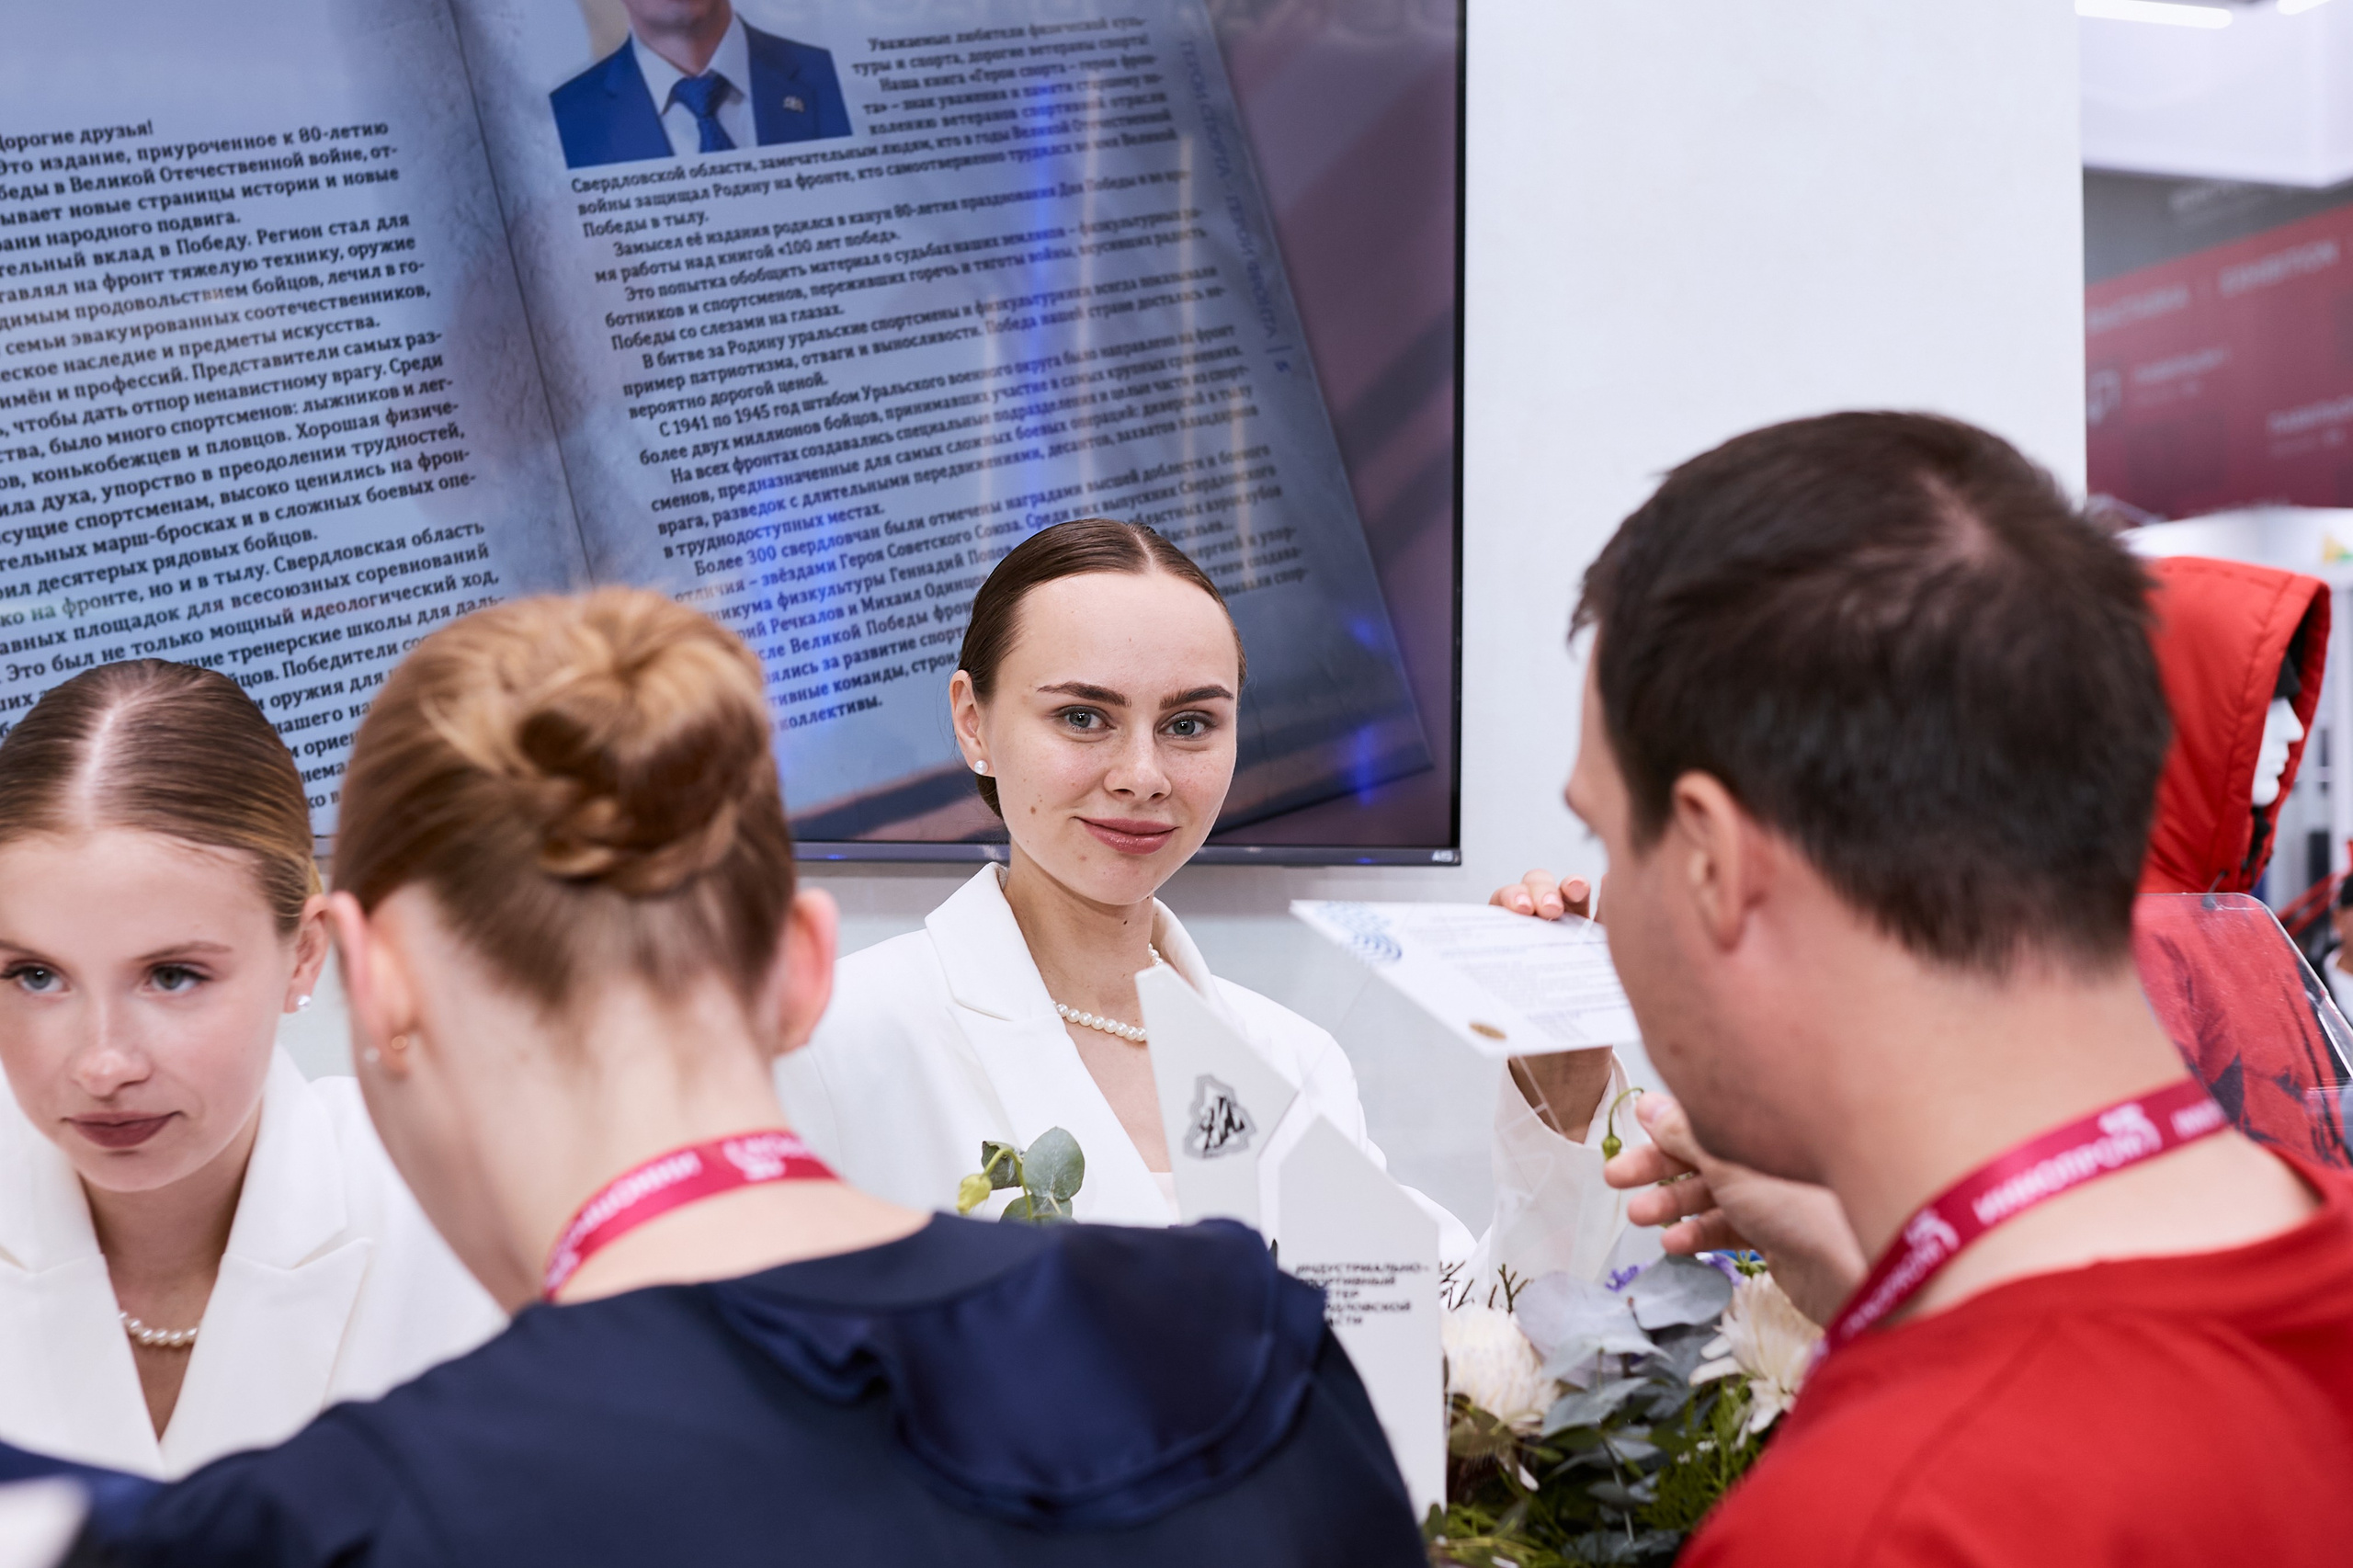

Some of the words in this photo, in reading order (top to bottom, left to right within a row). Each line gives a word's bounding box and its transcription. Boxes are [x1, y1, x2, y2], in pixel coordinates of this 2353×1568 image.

[40, 151, 131, 171] издание,
[137, 134, 277, 164] приуроченное
[298, 122, 389, 143] 80-летию
[80, 119, 153, 145] друзья!
[69, 168, 156, 193] Великой
[159, 152, 304, 183] Отечественной
[308, 147, 368, 166] войне,
[69, 199, 131, 219] новые
[137, 187, 235, 212] страницы
[241, 177, 320, 199] истории
[343, 168, 399, 186] новые
[571, 165, 687, 194] Свердловской
[688, 161, 758, 178] области,
[577, 198, 631, 216] войны
[634, 187, 710, 209] защищал
[711, 180, 770, 199] Родину
[795, 171, 856, 191] фронте,
[46, 222, 153, 248] народного
[156, 211, 241, 233] подвига.
[93, 246, 155, 266] вклад
[176, 234, 252, 256] Победу.
[256, 225, 324, 245] Регион
[328, 219, 370, 236] стал
[583, 219, 648, 238] Победы
[664, 210, 709, 227] тылу.
[613, 237, 684, 257] Замысел
[706, 225, 770, 244] издания
[772, 216, 835, 239] родился
[102, 269, 165, 293] фронт
[168, 258, 258, 280] тяжелую
[261, 247, 344, 268] технику,
[347, 237, 415, 260] оружие
[620, 260, 682, 284] работы
[717, 244, 775, 266] книгой
[778, 238, 813, 256] «100
[844, 230, 901, 247] побед».
[657, 277, 728, 297] попытка
[729, 265, 807, 286] обобщить
[809, 254, 881, 274] материал
[5, 335, 67, 356] семьи
[71, 312, 241, 346] эвакуированных
[244, 285, 431, 321] соотечественников,
[74, 284, 248, 322] продовольствием
[252, 275, 324, 294] бойцов,
[327, 266, 381, 285] лечил
[605, 306, 685, 328] ботников
[702, 288, 808, 313] спортсменов,
[63, 348, 156, 373] наследие
[178, 330, 278, 359] предметы
[281, 316, 381, 341] искусства.
[611, 330, 676, 350] Победы
[699, 316, 766, 336] слезами
[790, 304, 845, 323] глазах.
[656, 348, 705, 367] битве
[727, 335, 785, 356] Родину
[788, 323, 869, 349] уральские
[74, 366, 188, 401] профессий.
[191, 346, 340, 382] Представители
[343, 336, 403, 357] самых
[622, 375, 686, 399] пример
[689, 357, 799, 385] патриотизма,
[801, 347, 856, 366] отваги
[871, 326, 982, 354] выносливости.
[12, 411, 78, 434] чтобы
[82, 405, 129, 426] дать
[131, 394, 190, 415] отпор
[193, 372, 327, 405] ненавистному
[332, 364, 387, 386] врагу.
[389, 354, 443, 377] Среди
[49, 435, 103, 455] было
[106, 425, 167, 446] много
[170, 403, 298, 435] спортсменов:
[302, 386, 400, 414] лыжников
[629, 395, 707, 420] вероятно
[710, 380, 775, 407] дорогой
[777, 371, 828, 394] ценой.
[673, 415, 709, 435] 1941
[734, 403, 770, 425] 1945
[801, 391, 860, 412] штабом
[860, 376, 946, 403] Уральского
[31, 448, 181, 484] конькобежцев
[206, 430, 291, 455] пловцов.
[295, 415, 381, 440] Хорошая
[385, 402, 459, 428] физиче-
[639, 447, 688, 466] более
[692, 438, 730, 459] двух
[732, 422, 822, 449] миллионов
[824, 411, 883, 431] бойцов,
[695, 462, 731, 480] всех
[732, 449, 800, 475] фронтах
[801, 432, 894, 460] создавались
[41, 490, 97, 513] духа,
[101, 472, 197, 504] упорство
[219, 445, 347, 481] преодолении
[350, 421, 465, 458] трудностей,
[74, 495, 215, 530] спортсменам,
[220, 481, 290, 505] высоко
[295, 464, 386, 492] ценились
[417, 449, 470, 472] фрон-
[651, 490, 715, 512] сменов,
[717, 460, 860, 501] предназначенные
[895, 445, 944, 464] самых
[92, 516, 237, 554] марш-бросках
[275, 493, 362, 520] сложных
[366, 480, 435, 503] боевых
[657, 515, 710, 538] врага,
[711, 498, 787, 528] разведок
[802, 473, 911, 508] длительными
[677, 515, 824, 558] труднодоступных
[827, 503, 885, 524] местах.
[37, 560, 149, 596] десятерых
[152, 543, 240, 575] рядовых
[243, 529, 318, 553] бойцов.
[62, 588, 144, 619] фронте,
[213, 563, 269, 585] тылу.
[273, 537, 406, 574] Свердловская
[411, 523, 485, 547] область
[694, 555, 744, 577] Более
[748, 545, 778, 565] 300
[780, 527, 881, 558] свердловчан
[883, 517, 926, 536] были
[762, 560, 837, 586] звёздами
[839, 549, 885, 570] Героя
[886, 530, 972, 559] Советского
[73, 608, 180, 641] площадок
[231, 574, 351, 608] всесоюзных
[356, 542, 489, 585] соревнований
[777, 574, 886, 612] физкультуры
[889, 552, 964, 583] Геннадий
[131, 630, 204, 655] только
[210, 608, 295, 640] мощный
[301, 574, 457, 621] идеологический
[460, 571, 499, 588] ход,
[769, 607, 845, 634] Речкалов
[859, 589, 922, 613] Михаил
[790, 623, 862, 654] Великой
[866, 611, 929, 636] Победы
[227, 629, 342, 665] тренерские
[346, 613, 413, 639] школы
[281, 642, 398, 678] Победители
[843, 638, 916, 670] развитие
[270, 681, 345, 710] оружия
[833, 665, 909, 693] команды,
